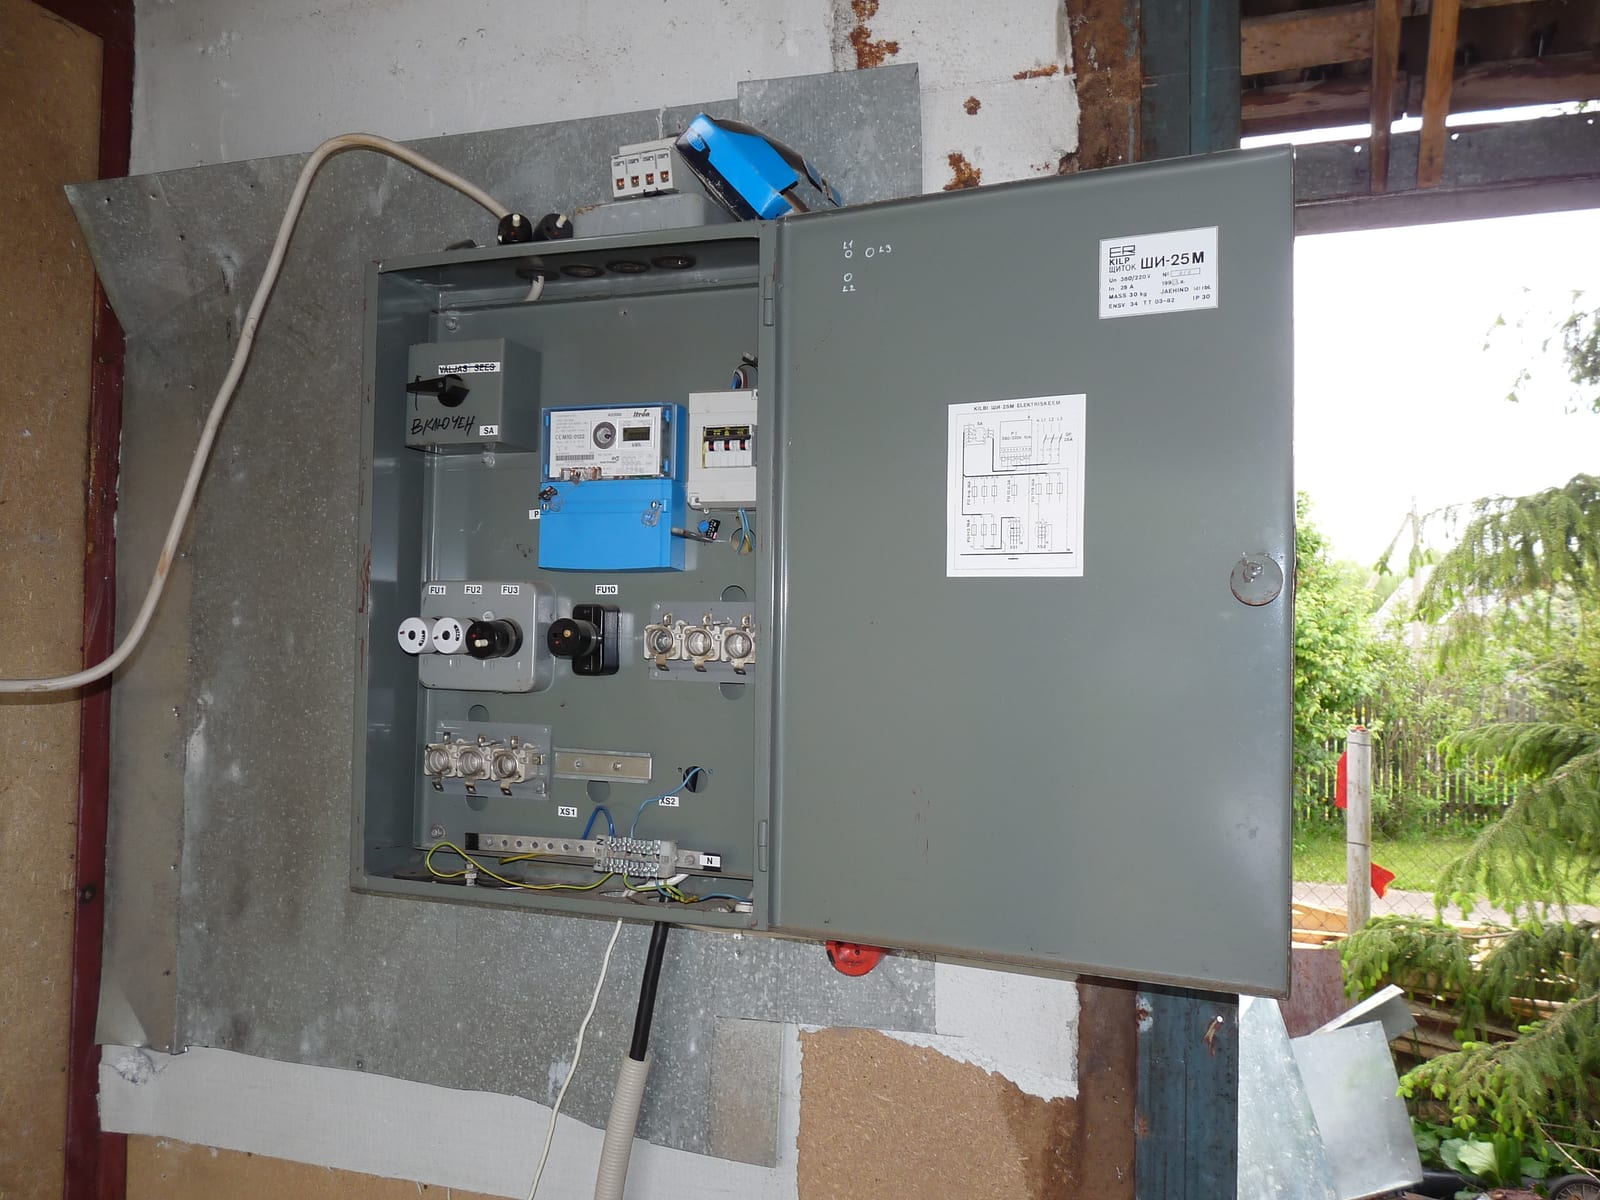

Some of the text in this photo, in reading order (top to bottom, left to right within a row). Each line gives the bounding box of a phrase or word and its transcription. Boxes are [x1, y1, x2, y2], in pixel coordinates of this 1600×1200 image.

[1109, 257, 1130, 266] KILP
[483, 426, 494, 435] SA
[502, 586, 518, 594] FU3
[596, 586, 616, 594] FU10
[660, 797, 676, 805] XS2
[560, 808, 575, 816] XS1
[706, 857, 713, 865] N
